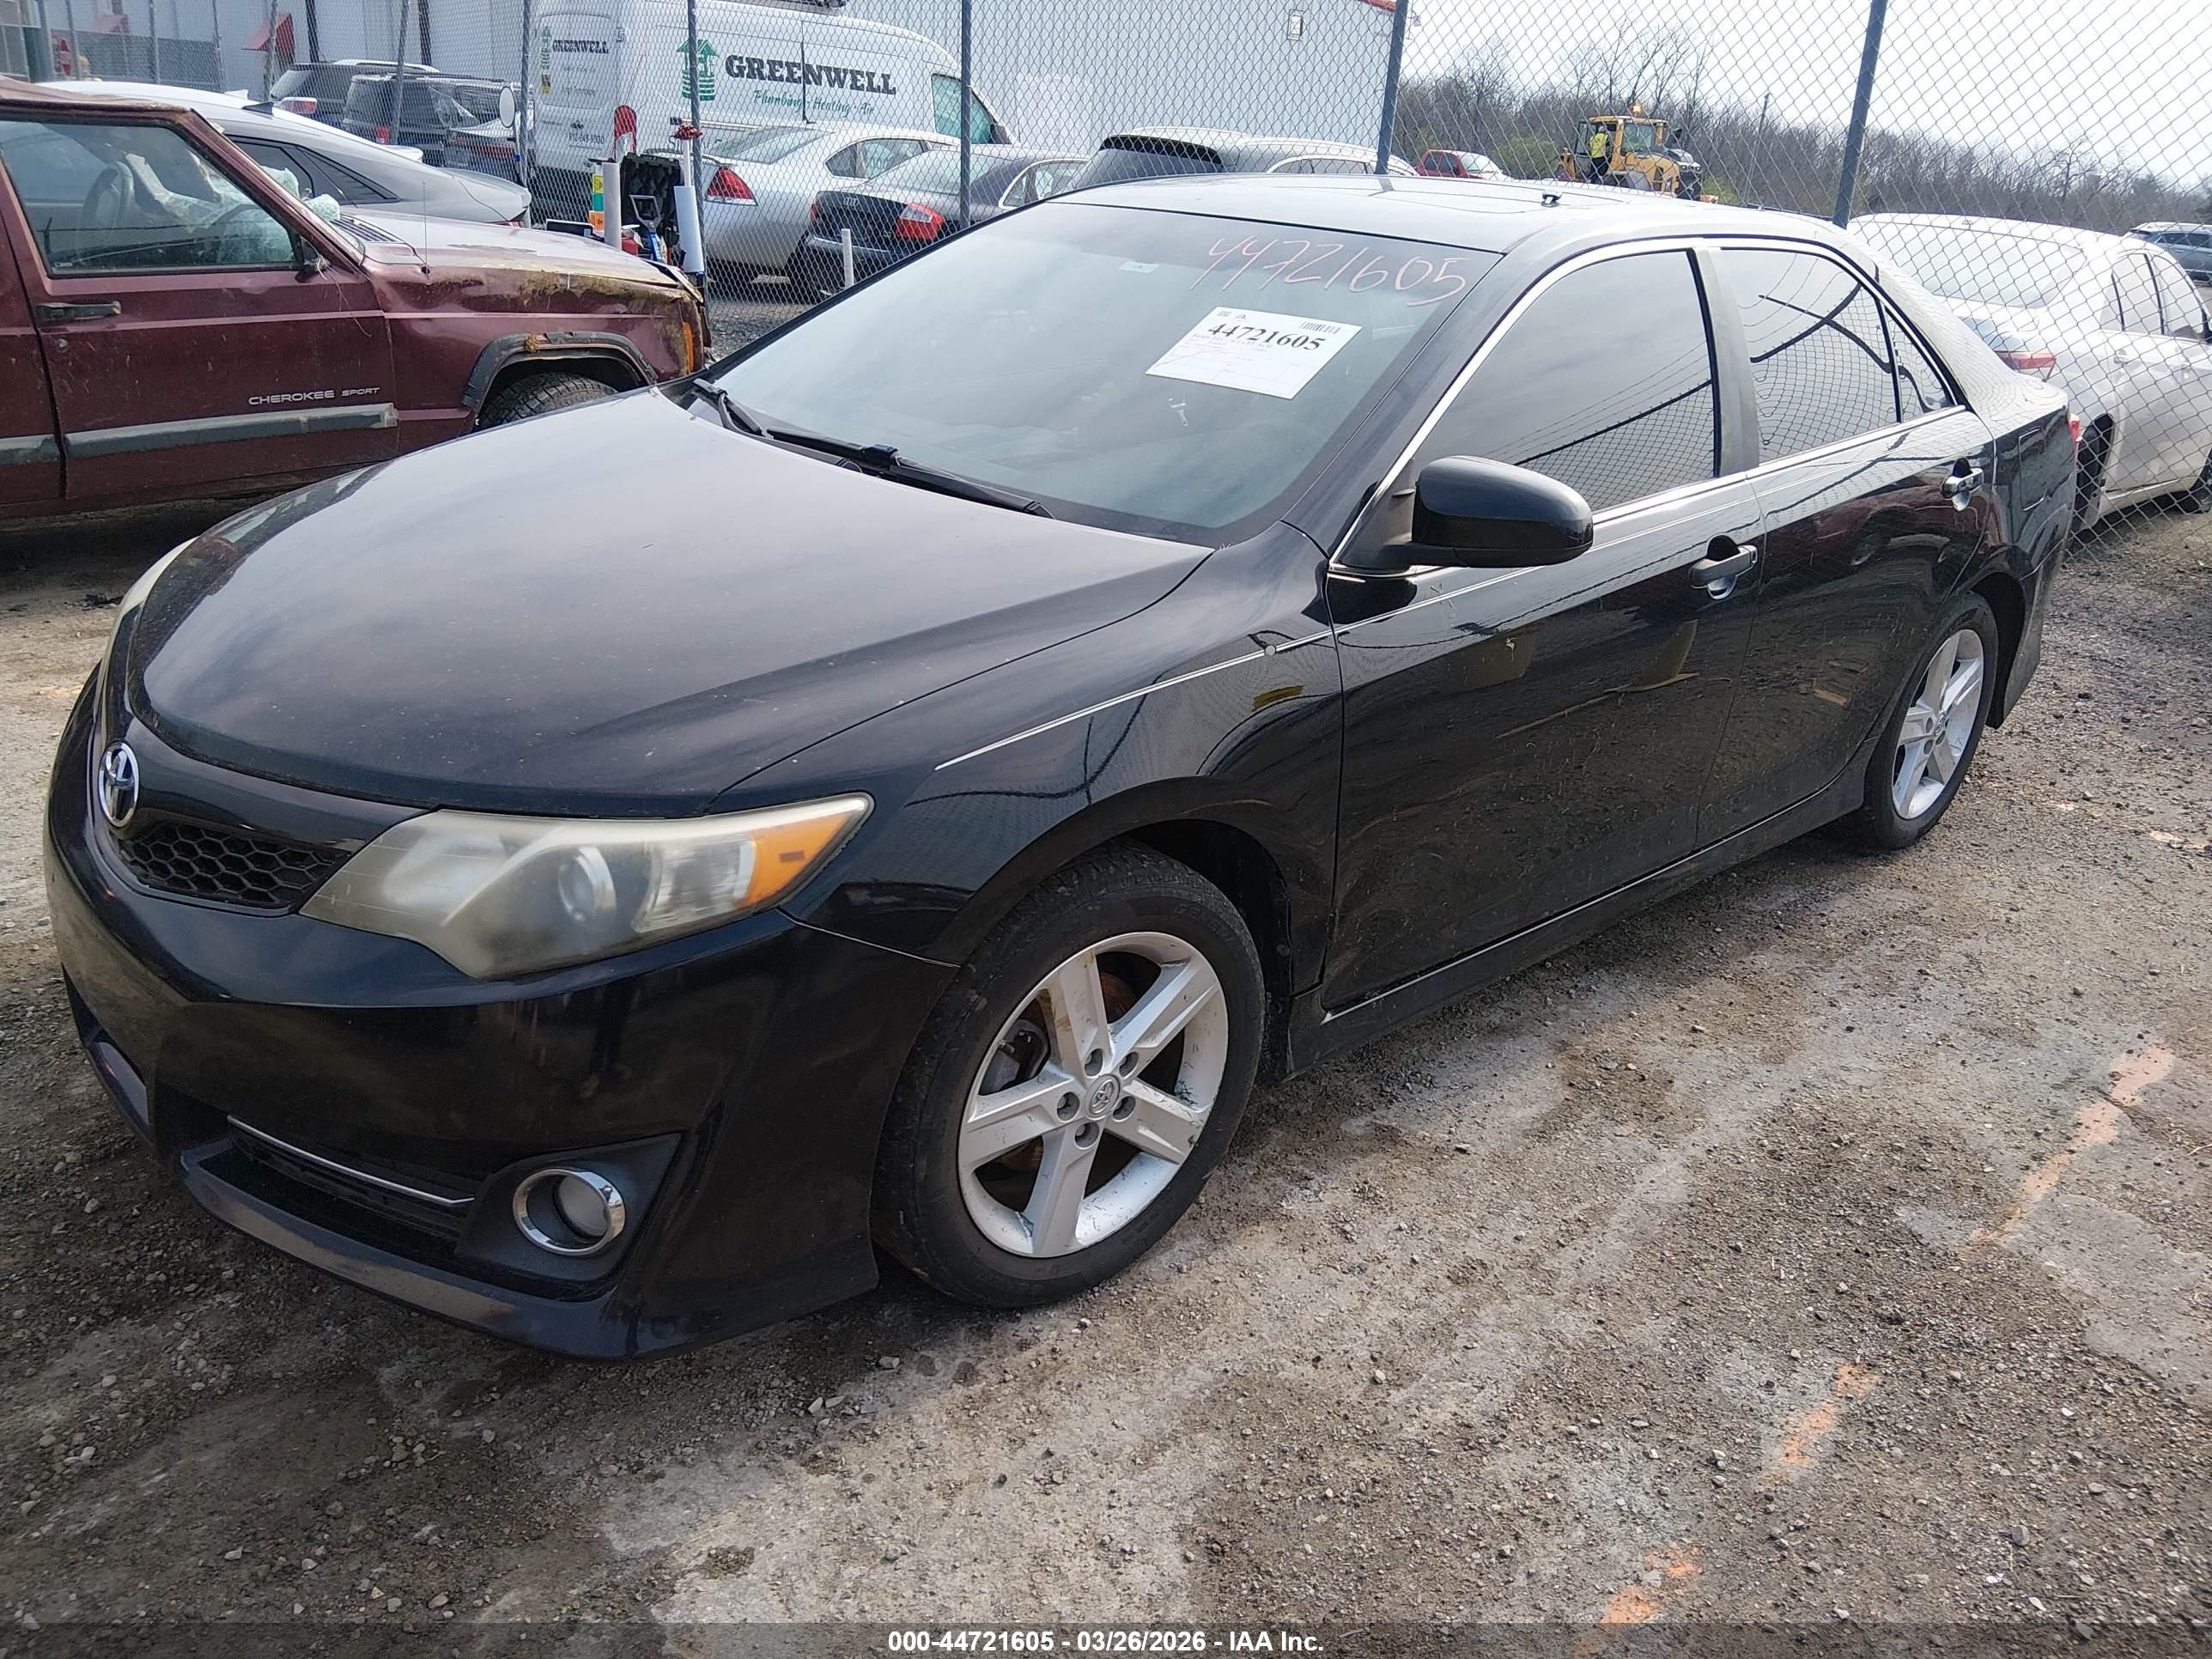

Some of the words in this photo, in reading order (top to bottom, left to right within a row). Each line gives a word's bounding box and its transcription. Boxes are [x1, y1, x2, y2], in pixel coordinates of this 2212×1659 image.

[552, 40, 610, 54] GREENWELL
[725, 54, 897, 95] GREENWELL
[753, 88, 803, 113] Plumbing
[812, 96, 851, 118] Heating
[858, 102, 875, 116] Air
[1190, 235, 1471, 307] 44721605
[1207, 323, 1327, 351] 44721605
[248, 389, 335, 405] CHEROKEE
[341, 386, 380, 397] SPORT
